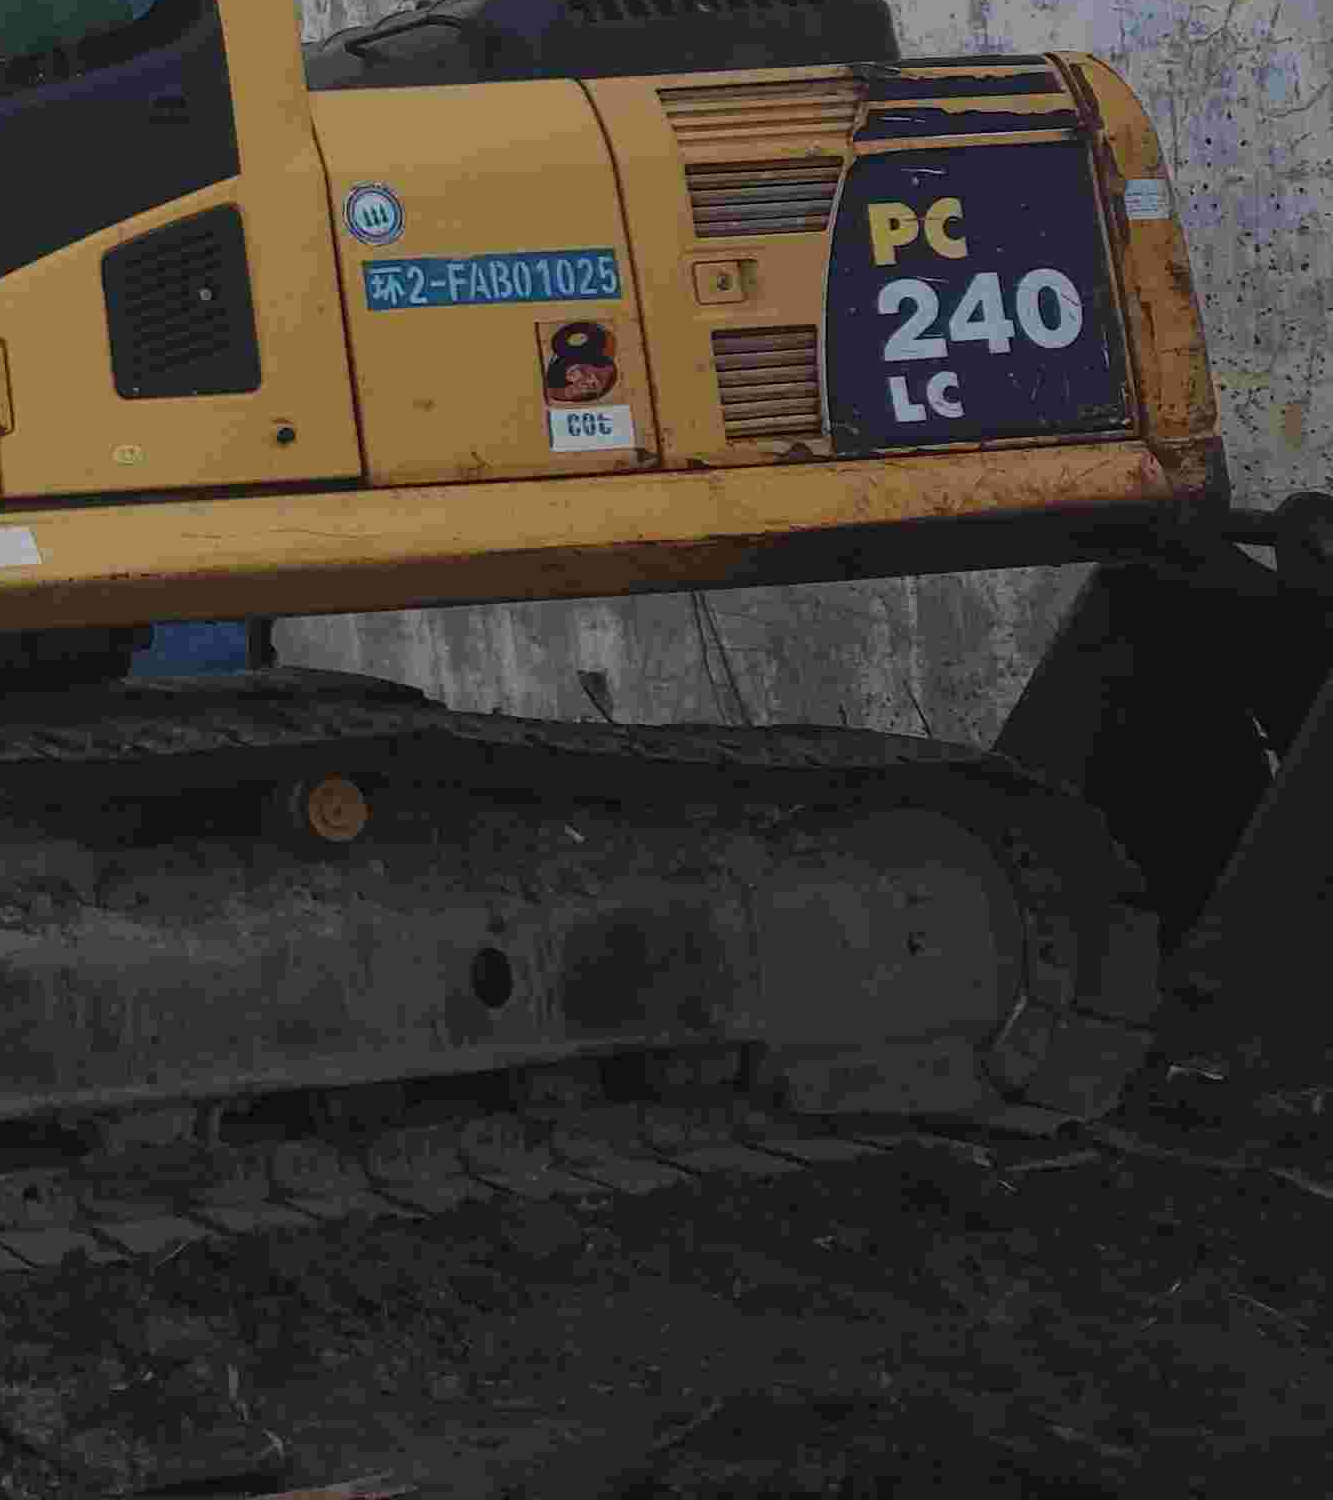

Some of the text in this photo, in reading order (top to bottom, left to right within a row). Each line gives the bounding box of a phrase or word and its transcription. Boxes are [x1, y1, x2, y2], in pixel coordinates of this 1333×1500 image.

[867, 197, 968, 267] PC
[877, 267, 1083, 362] 240
[887, 371, 966, 423] LC
